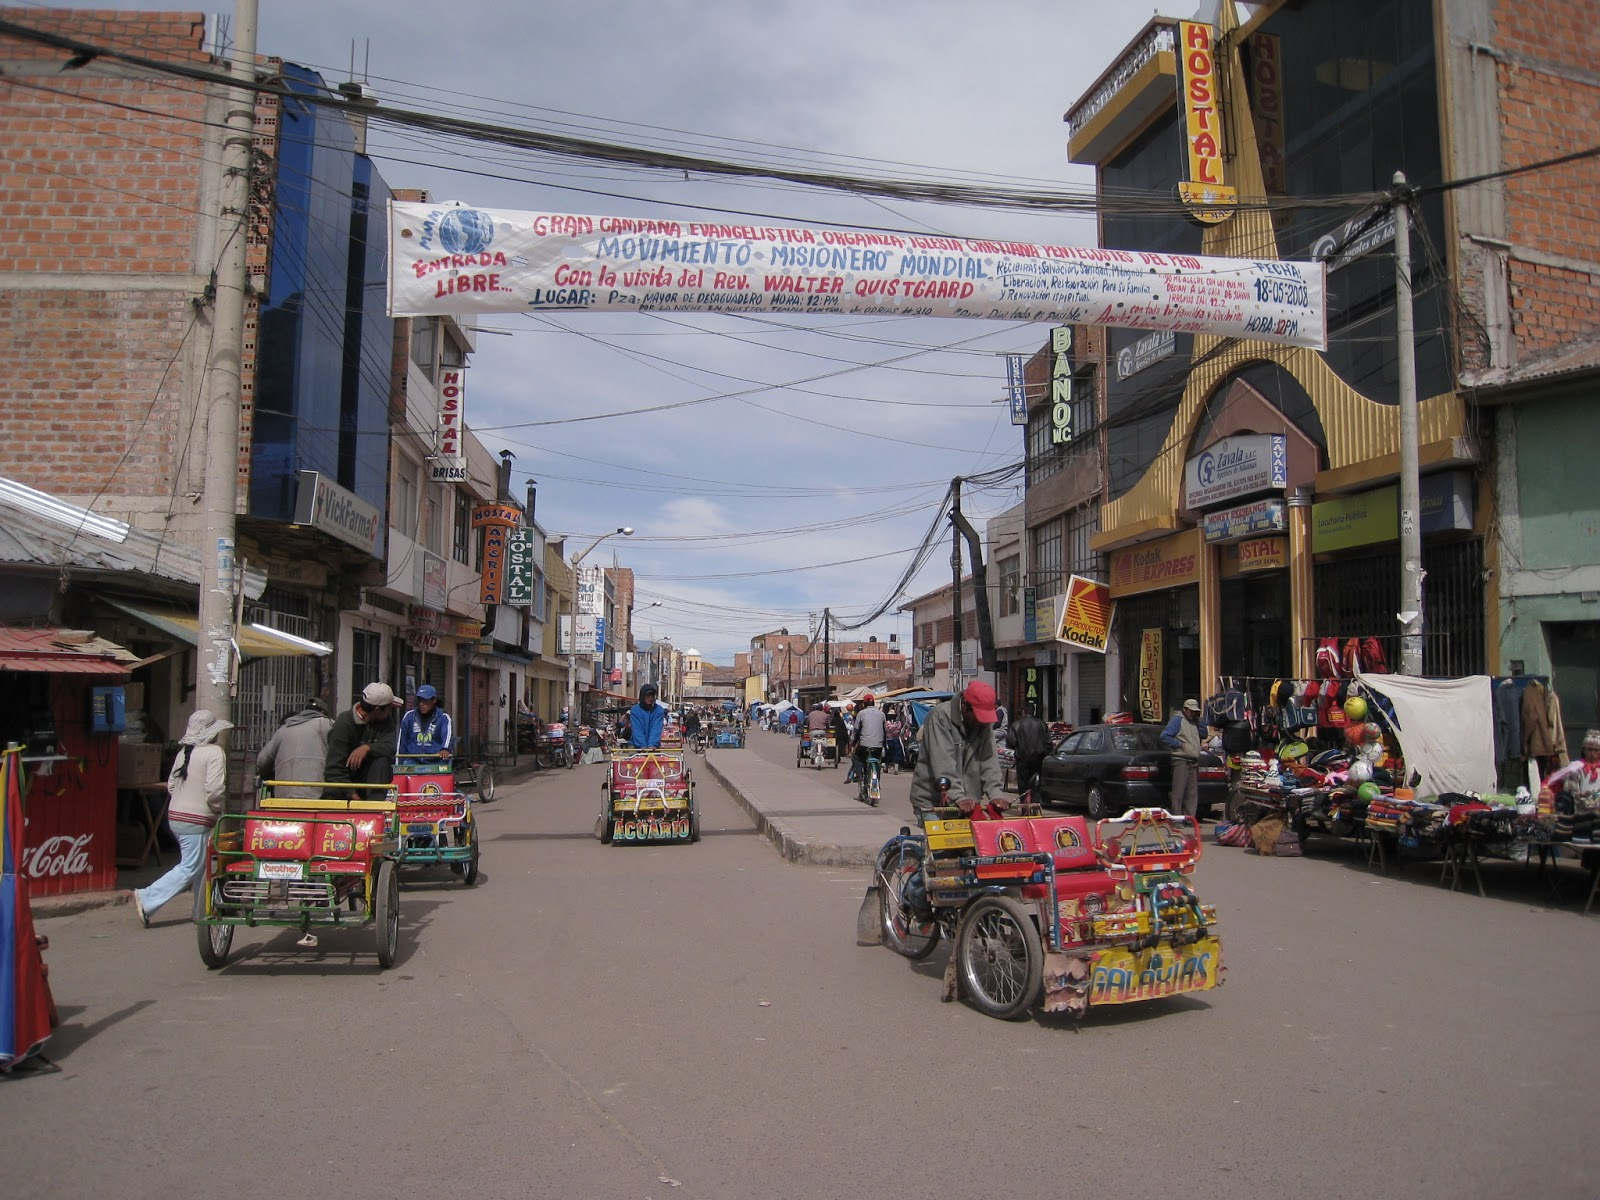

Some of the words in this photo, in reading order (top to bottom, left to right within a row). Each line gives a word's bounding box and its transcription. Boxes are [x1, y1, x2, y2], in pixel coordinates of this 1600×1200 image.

[1187, 24, 1217, 184] HOSTAL
[533, 215, 593, 238] GRAN
[689, 222, 816, 244] EVANGELISTICA
[1139, 251, 1169, 267] DEL
[411, 250, 508, 279] ENTRADA
[596, 236, 751, 266] MOVIMIENTO
[770, 244, 888, 272] MISIONERO
[899, 253, 988, 280] MUNDIAL
[554, 263, 593, 287] Con
[598, 264, 617, 287] la
[623, 265, 673, 289] visita
[677, 267, 704, 289] del
[713, 271, 751, 291] Rev.
[764, 274, 844, 294] WALTER
[527, 288, 597, 306] LUGAR:
[683, 293, 695, 304] DE
[442, 372, 460, 455] HOSTAL
[1052, 427, 1072, 443] WC
[1217, 447, 1244, 469] Zavala
[1273, 436, 1284, 482] ZAVALA
[432, 466, 466, 479] BRISAS
[474, 506, 519, 523] HOSTAL
[509, 528, 527, 598] HOSTAL
[1133, 550, 1161, 567] Kodak
[1144, 554, 1196, 580] EXPRESS
[1061, 625, 1104, 648] Kodak
[1142, 667, 1154, 720] FOTOS
[613, 818, 690, 840] ACUARIO
[264, 864, 299, 874] brother
